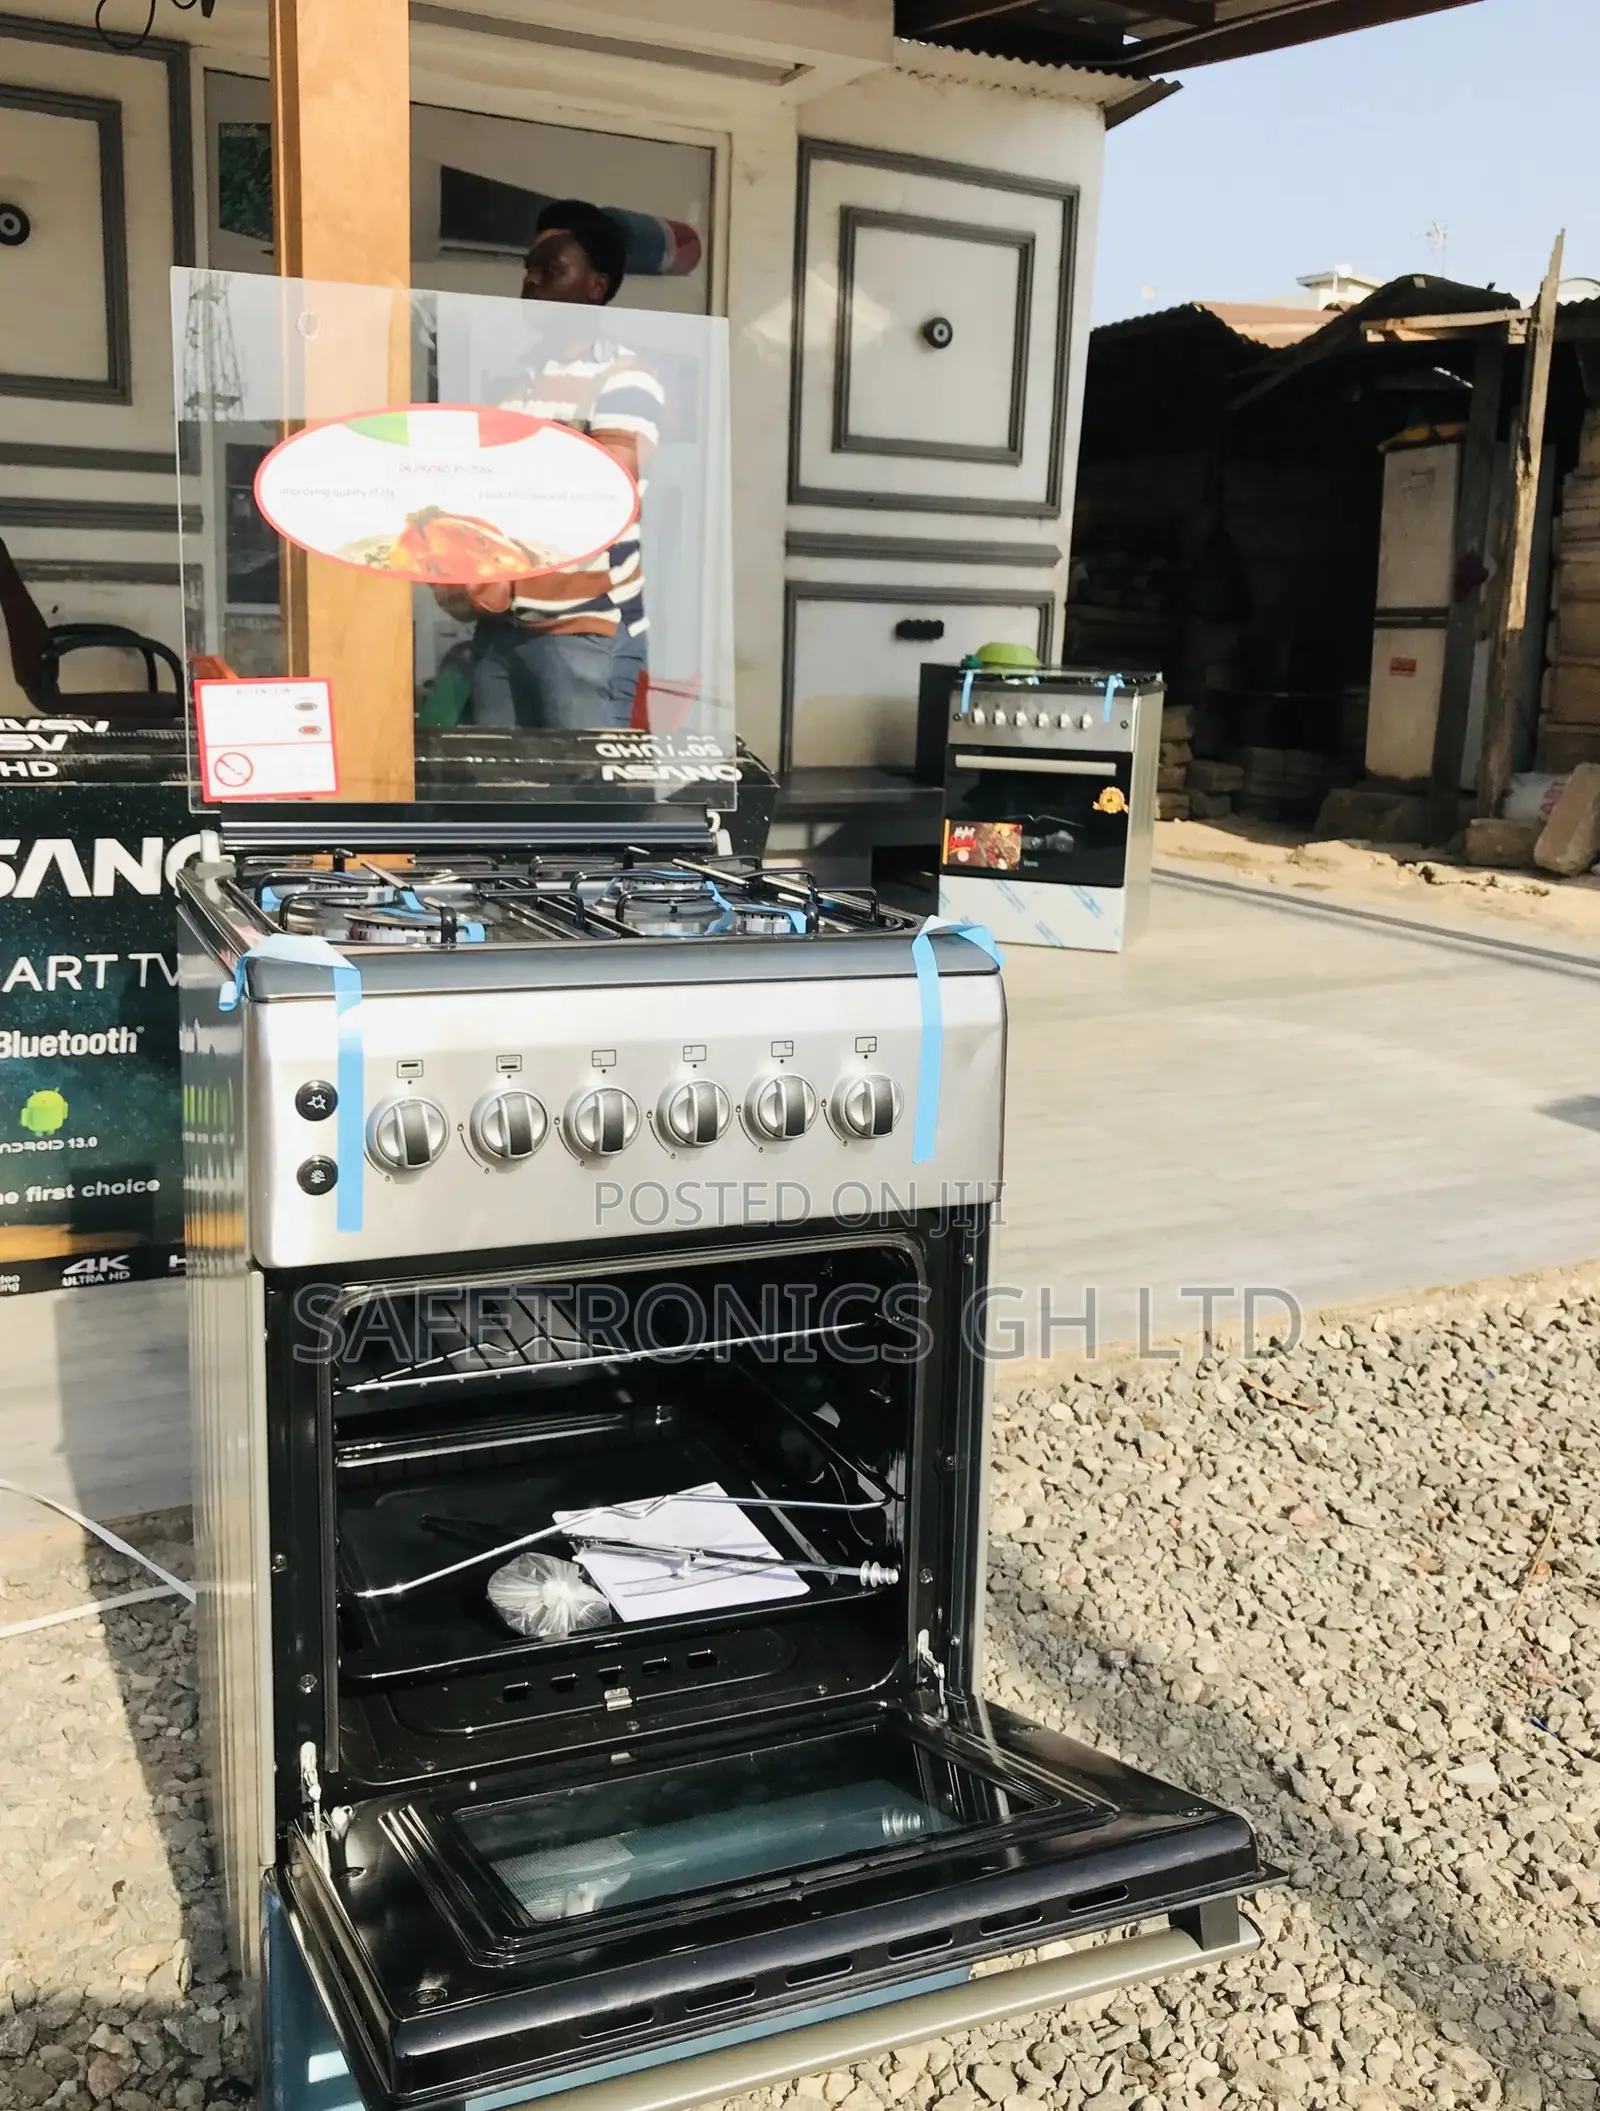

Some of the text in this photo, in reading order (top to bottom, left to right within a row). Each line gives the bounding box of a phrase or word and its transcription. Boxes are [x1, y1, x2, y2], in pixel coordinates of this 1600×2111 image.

[2, 953, 118, 993] ART
[67, 1136, 98, 1149] 13.0
[25, 1183, 75, 1202] first
[81, 1178, 160, 1198] choice
[61, 1254, 130, 1275] 4K
